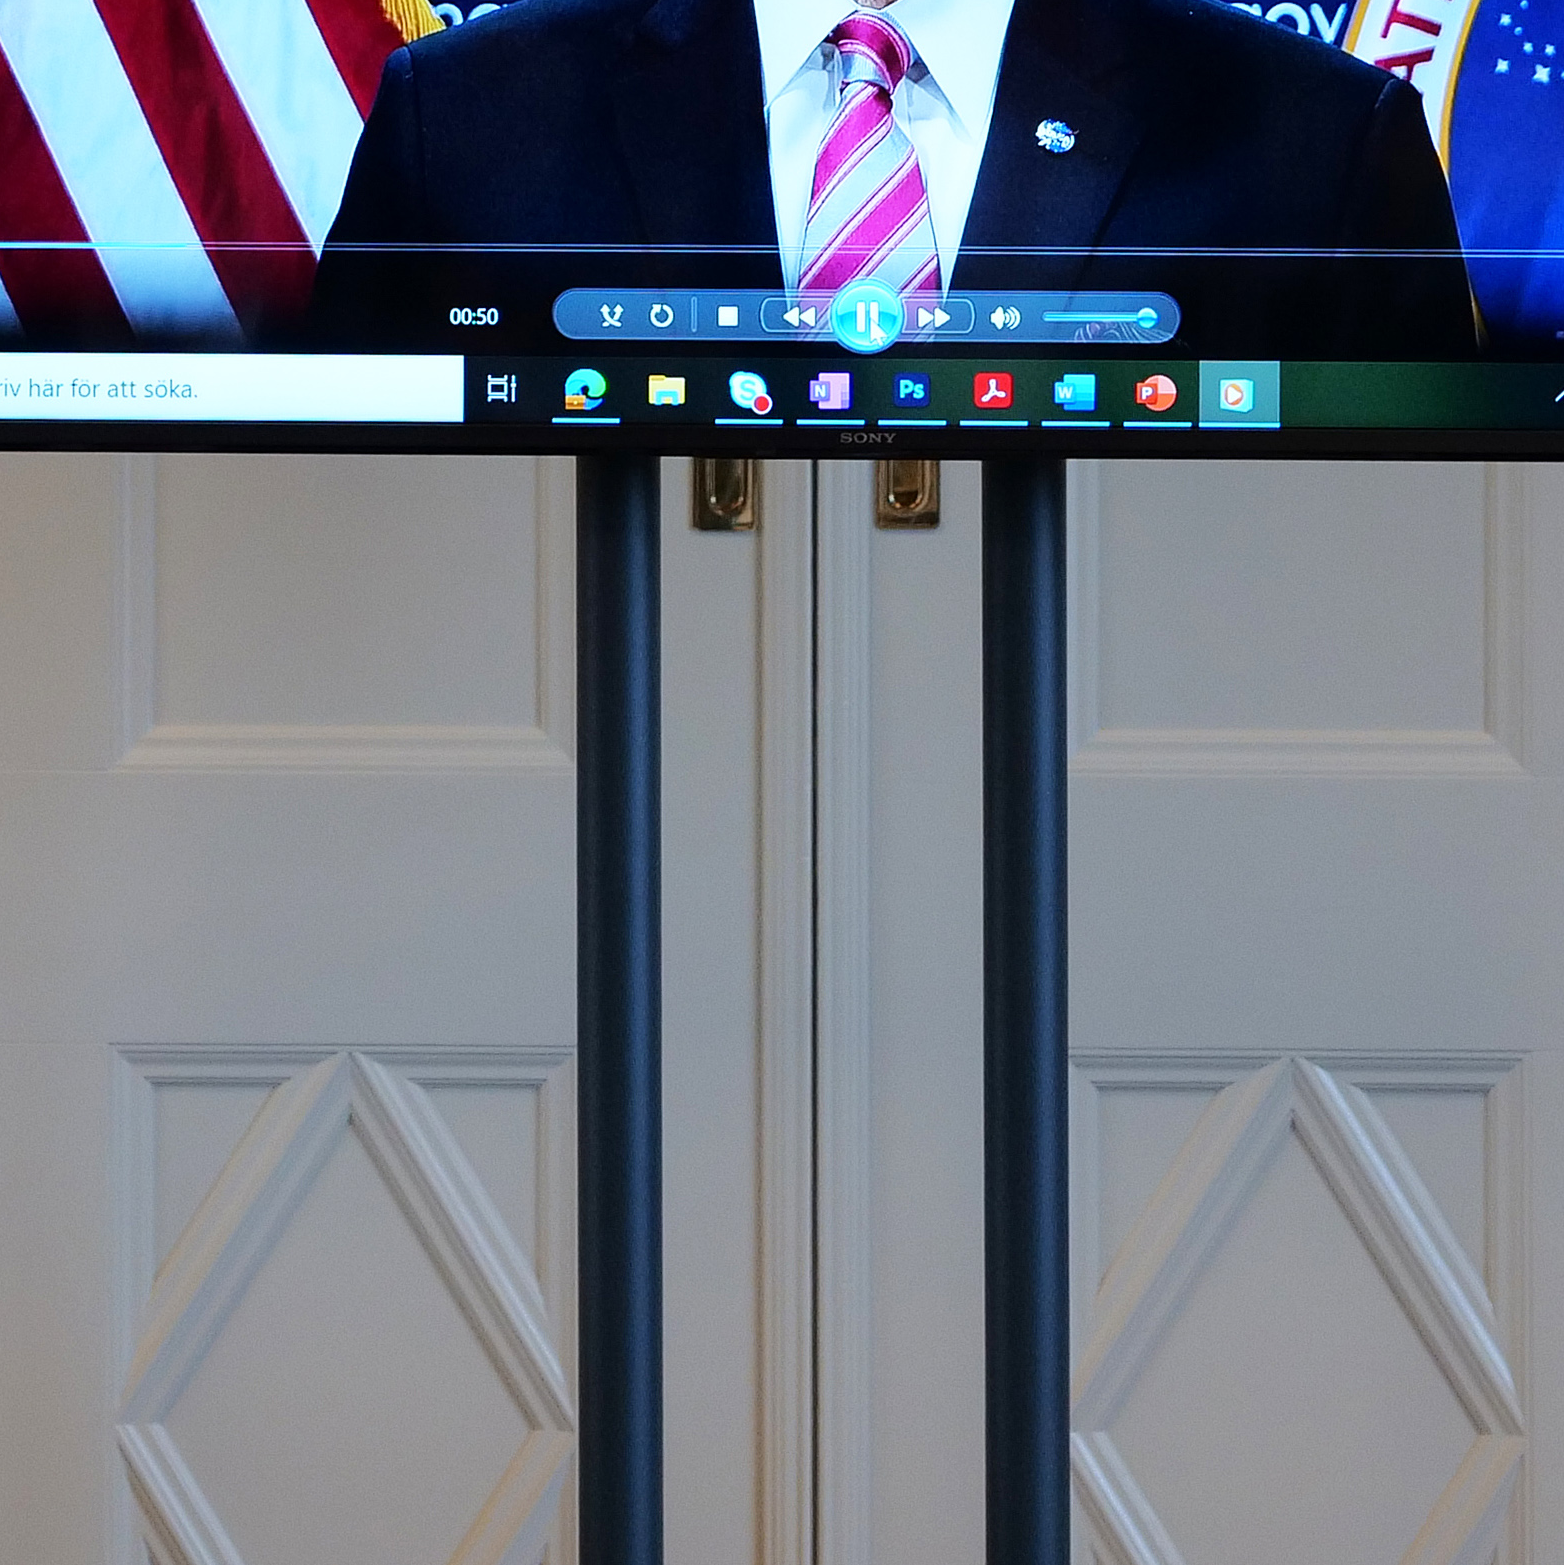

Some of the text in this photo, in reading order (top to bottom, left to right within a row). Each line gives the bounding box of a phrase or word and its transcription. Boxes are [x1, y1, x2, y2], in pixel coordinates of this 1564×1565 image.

[449, 307, 499, 326] 00:50
[29, 378, 64, 398] här
[70, 378, 101, 399] för
[107, 380, 137, 399] att
[143, 379, 198, 399] söka.
[814, 385, 826, 398] N
[899, 379, 925, 399] Ps
[1057, 385, 1074, 399] W
[1141, 386, 1154, 400] P
[840, 432, 896, 444] SONY
